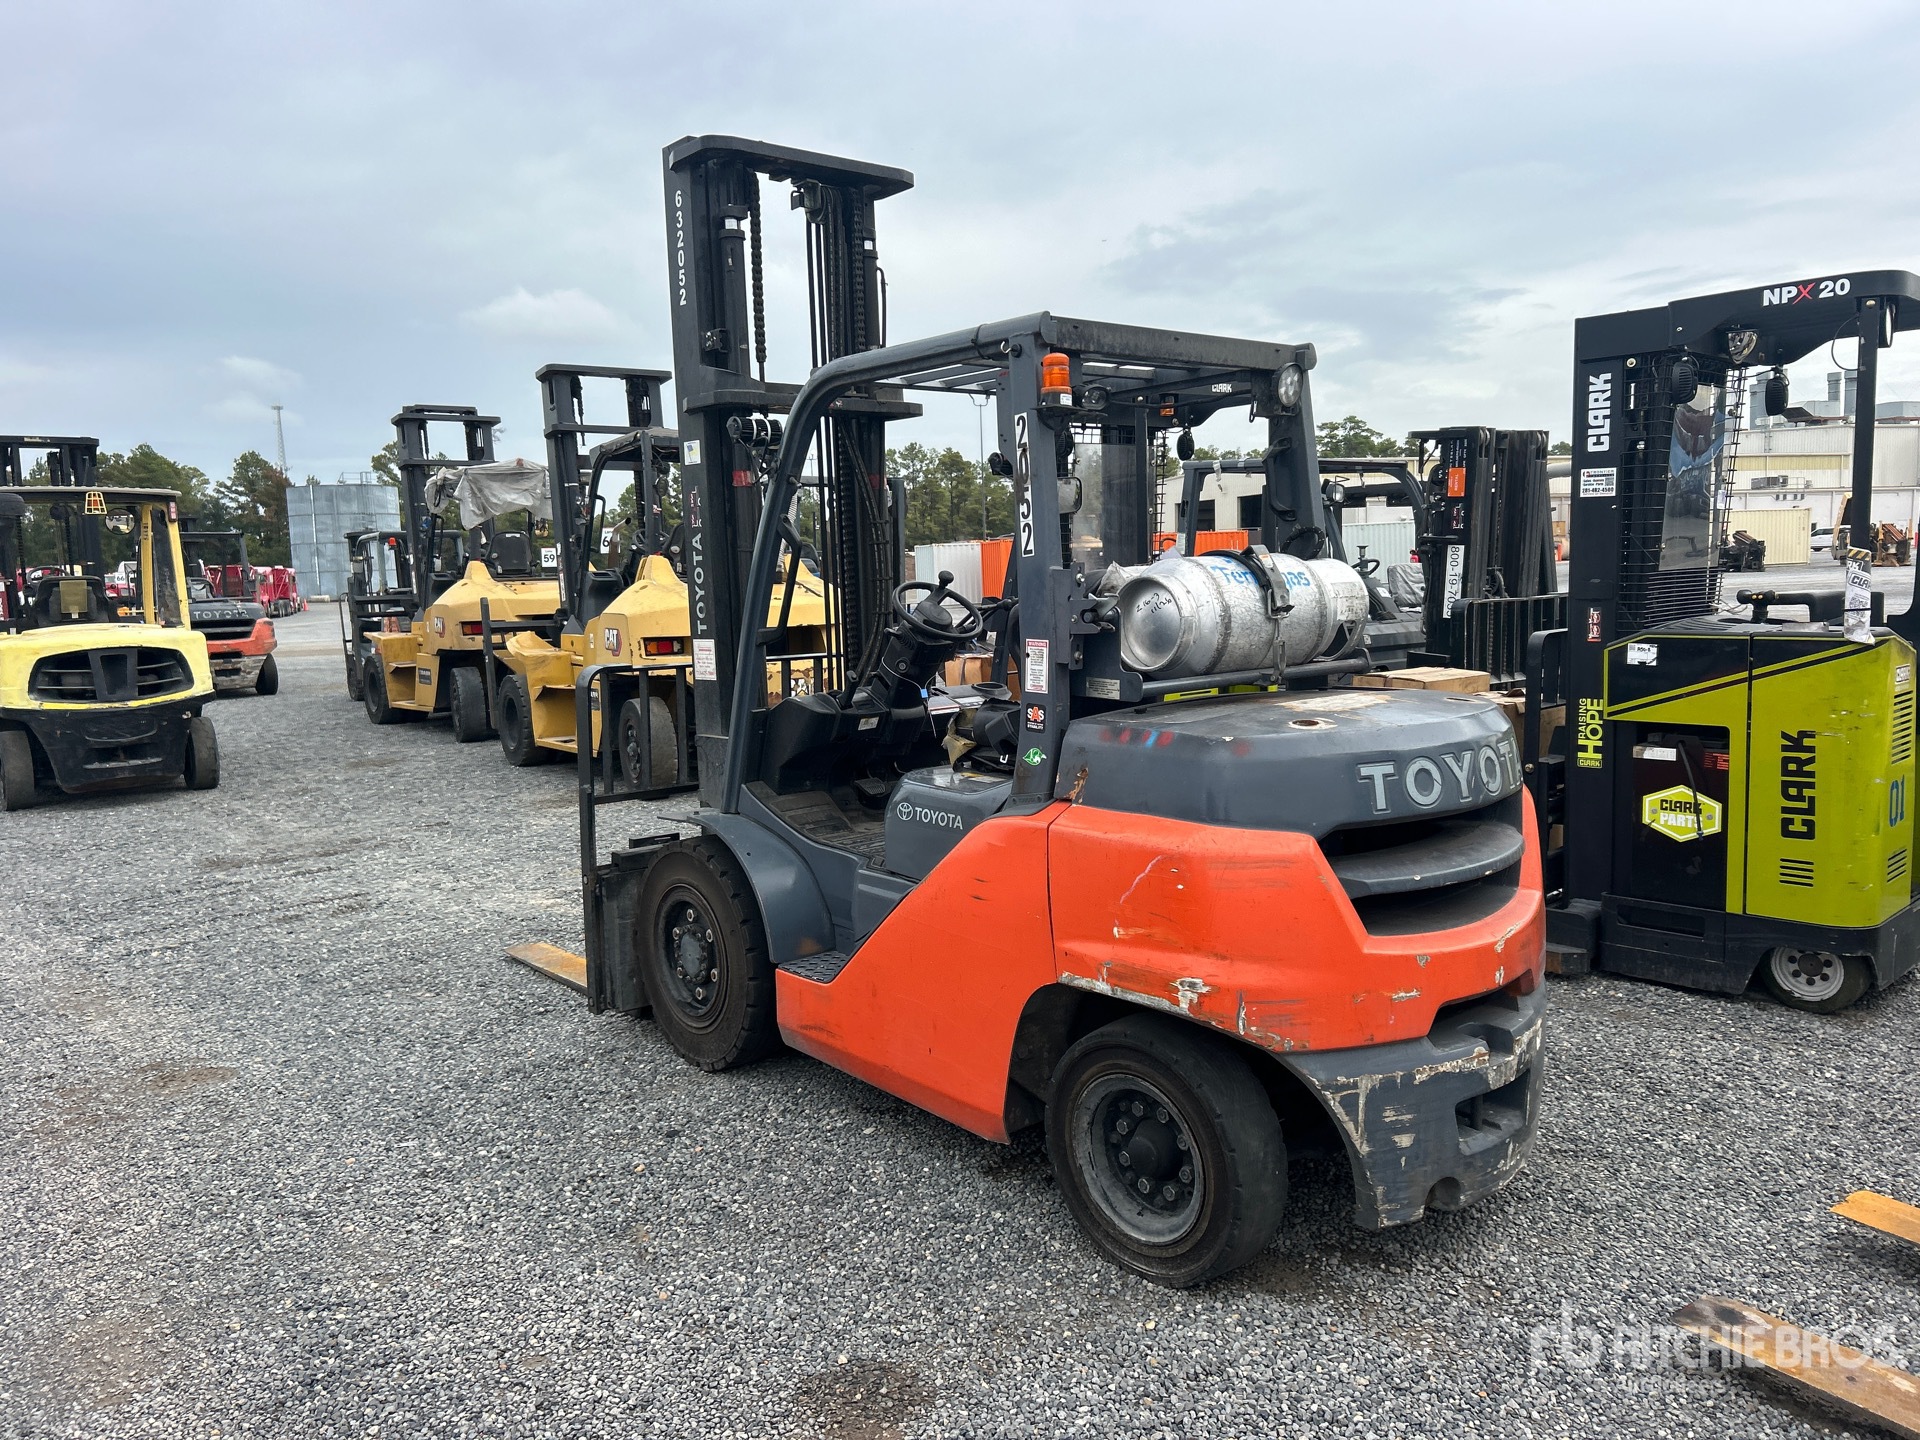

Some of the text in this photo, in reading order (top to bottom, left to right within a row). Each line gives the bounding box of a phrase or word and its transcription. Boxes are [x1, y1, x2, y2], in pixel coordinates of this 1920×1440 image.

[675, 190, 687, 306] 632052
[1763, 278, 1851, 306] NPX 20
[1211, 383, 1233, 393] CLARK
[1587, 373, 1612, 452] CLARK
[543, 553, 556, 563] 59
[691, 532, 708, 635] TOYOTA
[434, 617, 444, 633] CAT
[604, 628, 618, 650] CAT
[1027, 706, 1045, 723] SAS
[1578, 698, 1587, 739] RAISING
[1577, 698, 1604, 760] HOPE
[1579, 759, 1601, 767] CLARK
[1780, 730, 1817, 841] CLARK
[1889, 774, 1905, 828] 01
[914, 806, 963, 830] TOYOTA
